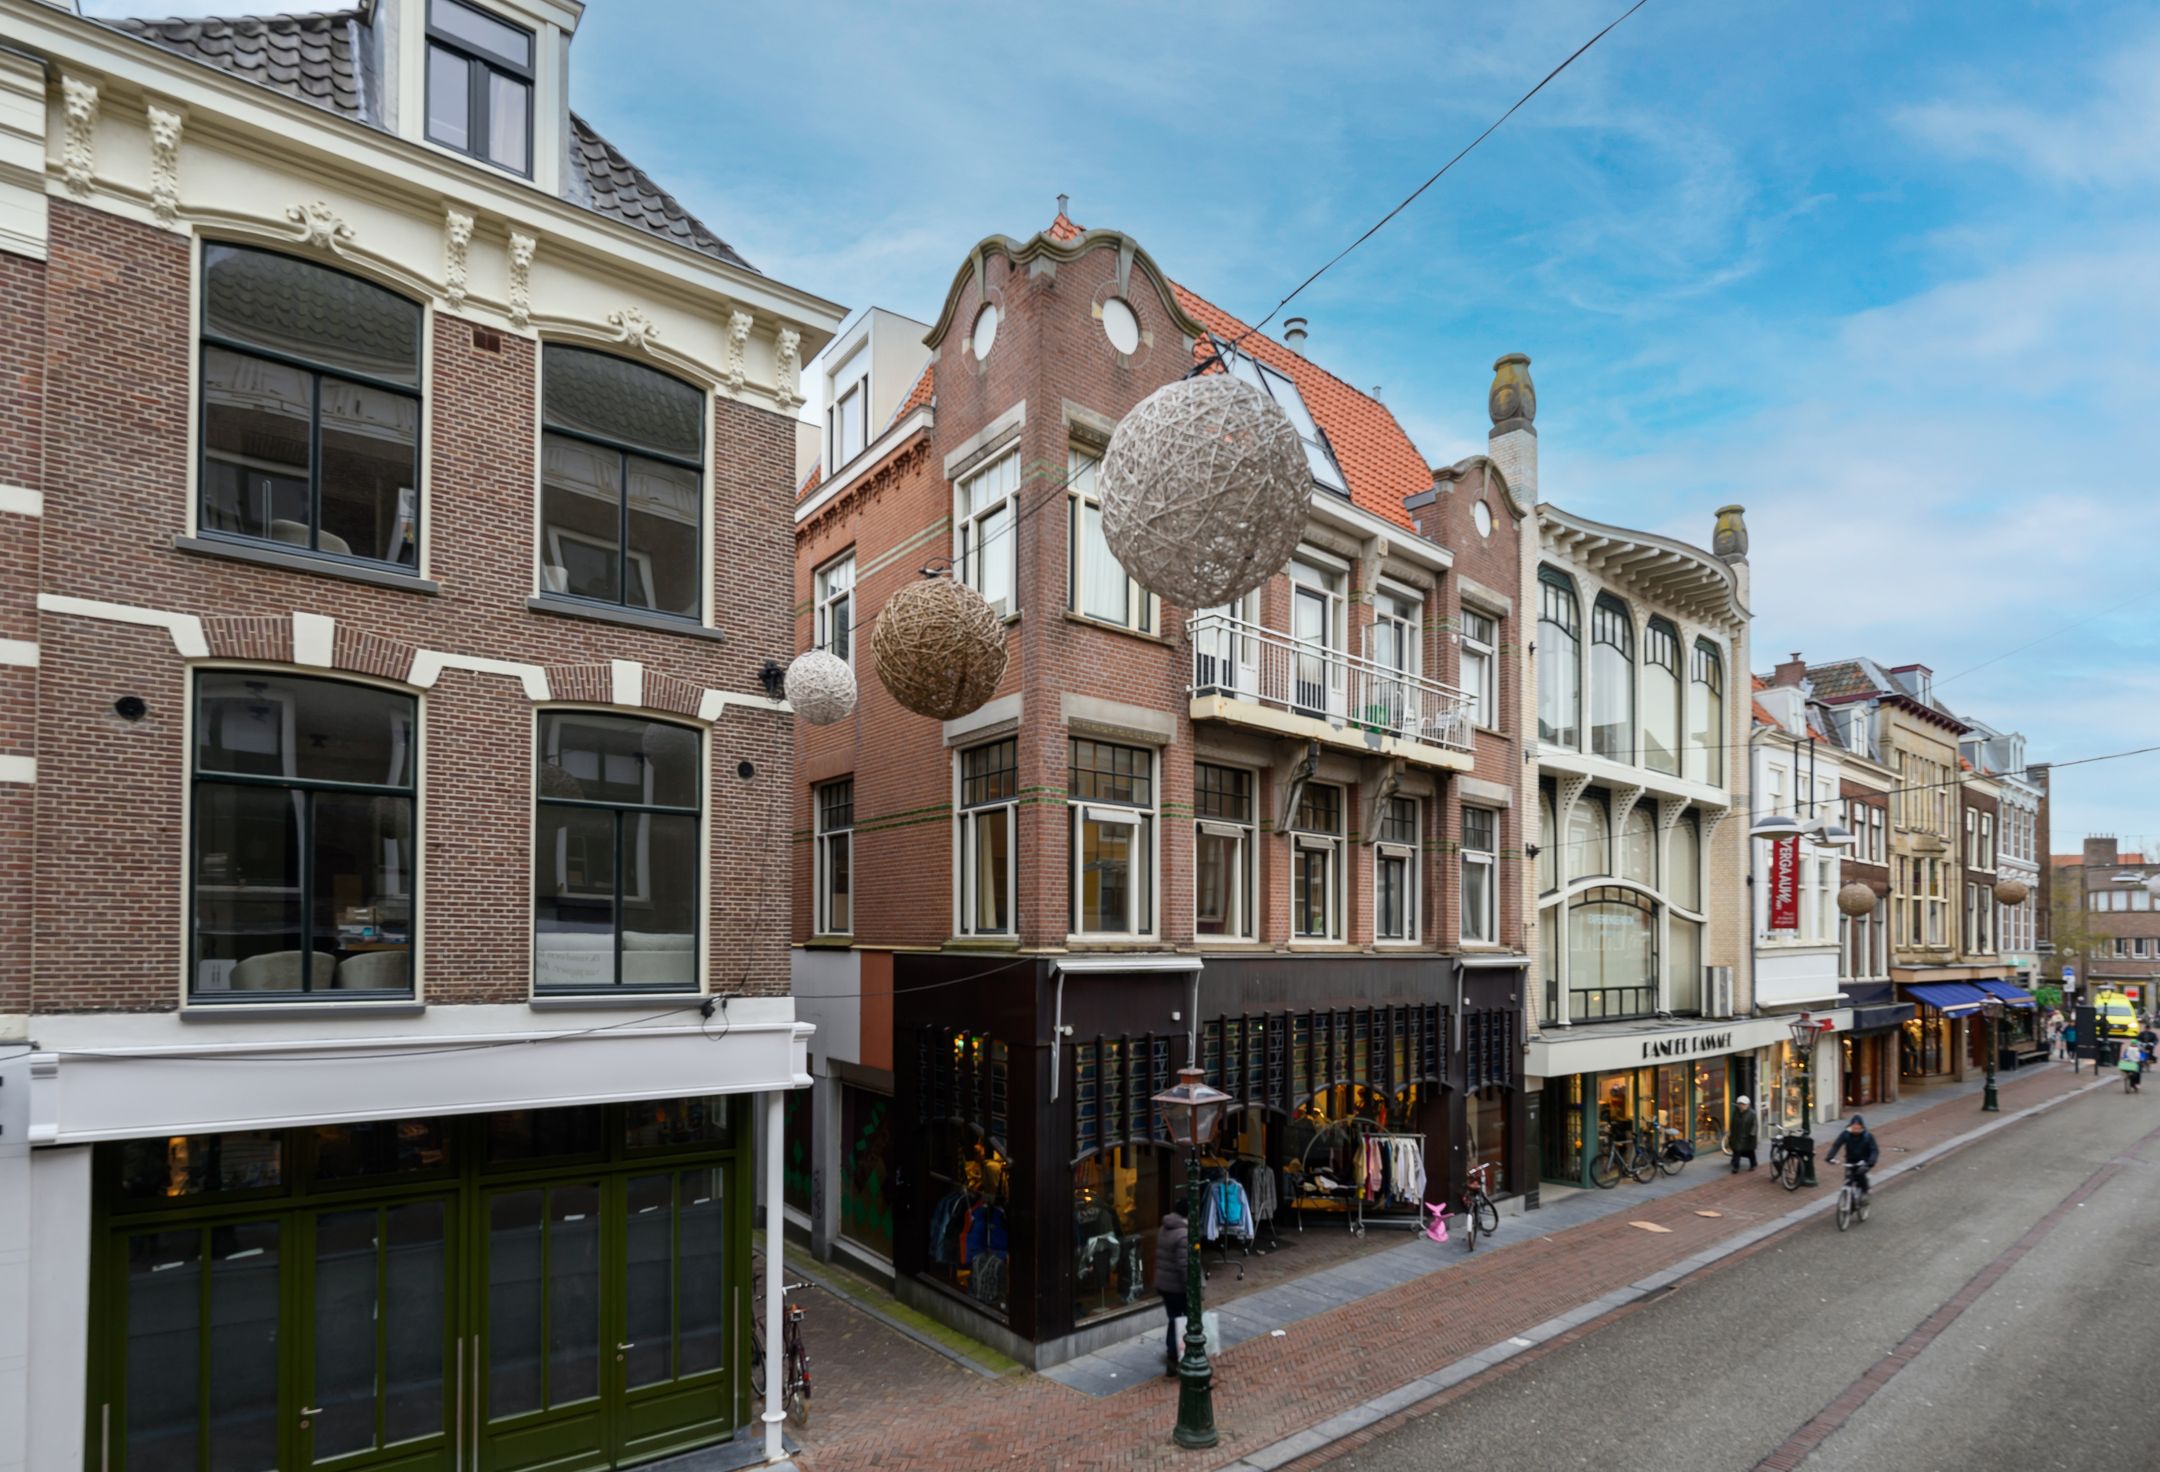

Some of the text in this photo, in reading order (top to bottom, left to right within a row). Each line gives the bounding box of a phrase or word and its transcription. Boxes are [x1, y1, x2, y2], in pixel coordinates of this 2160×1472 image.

[1777, 835, 1794, 904] VERGAAUW
[1642, 1032, 1732, 1059] PANDER PASSAGE
